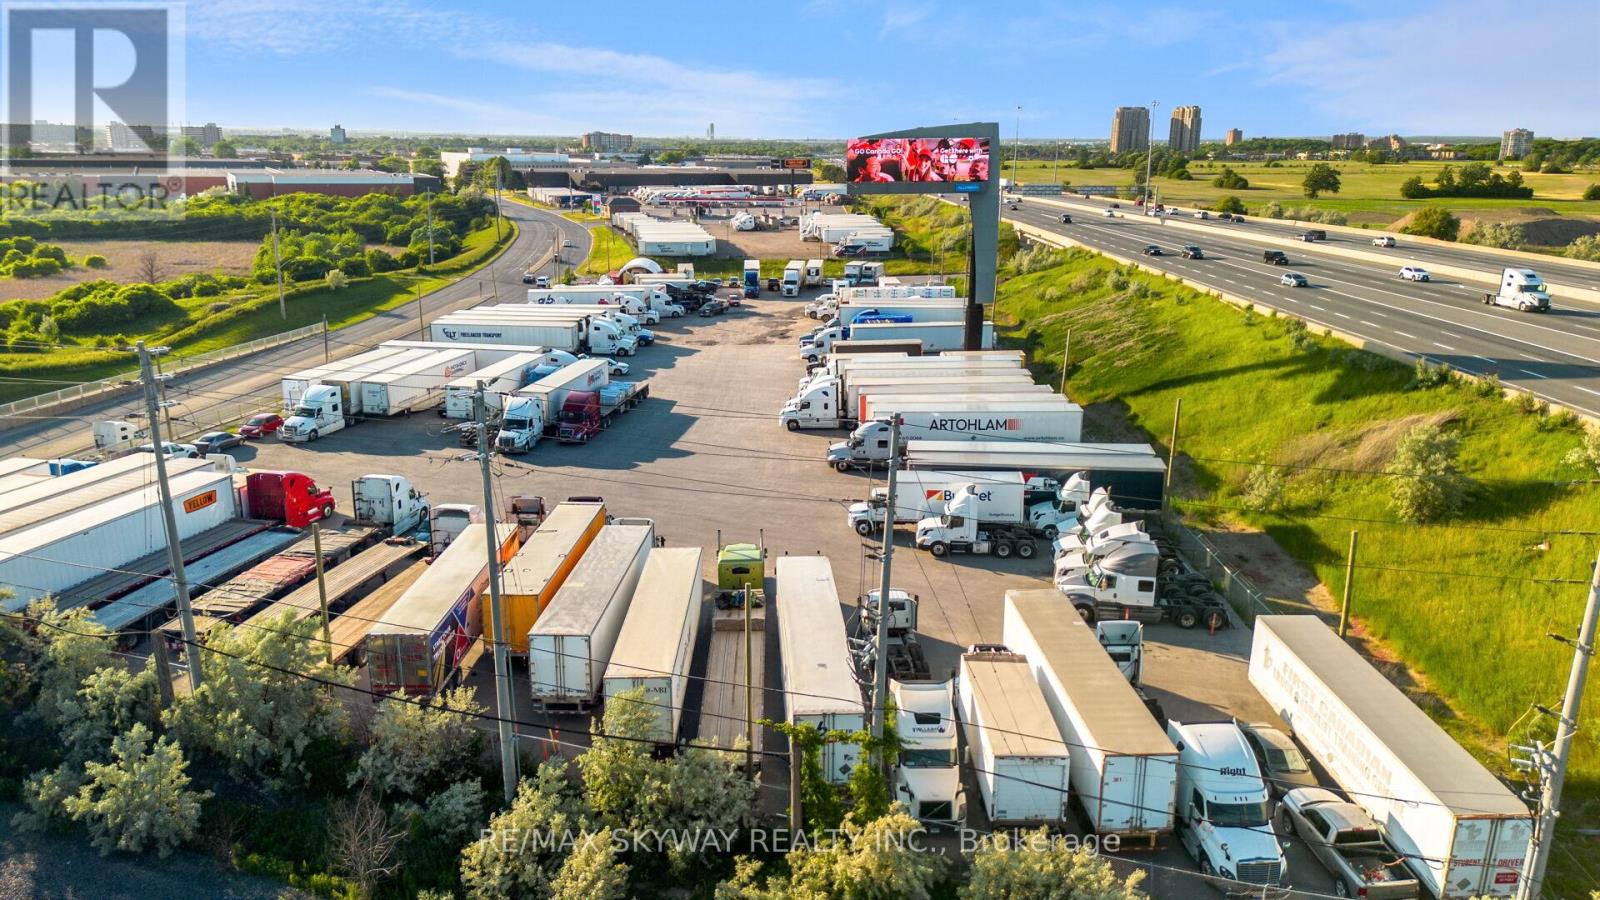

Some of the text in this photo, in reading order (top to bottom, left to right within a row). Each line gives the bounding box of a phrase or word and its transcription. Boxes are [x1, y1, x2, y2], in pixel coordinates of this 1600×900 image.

[929, 418, 1007, 431] ARTOHLAM
[188, 493, 213, 510] YELLOW
[1219, 766, 1247, 776] Right
